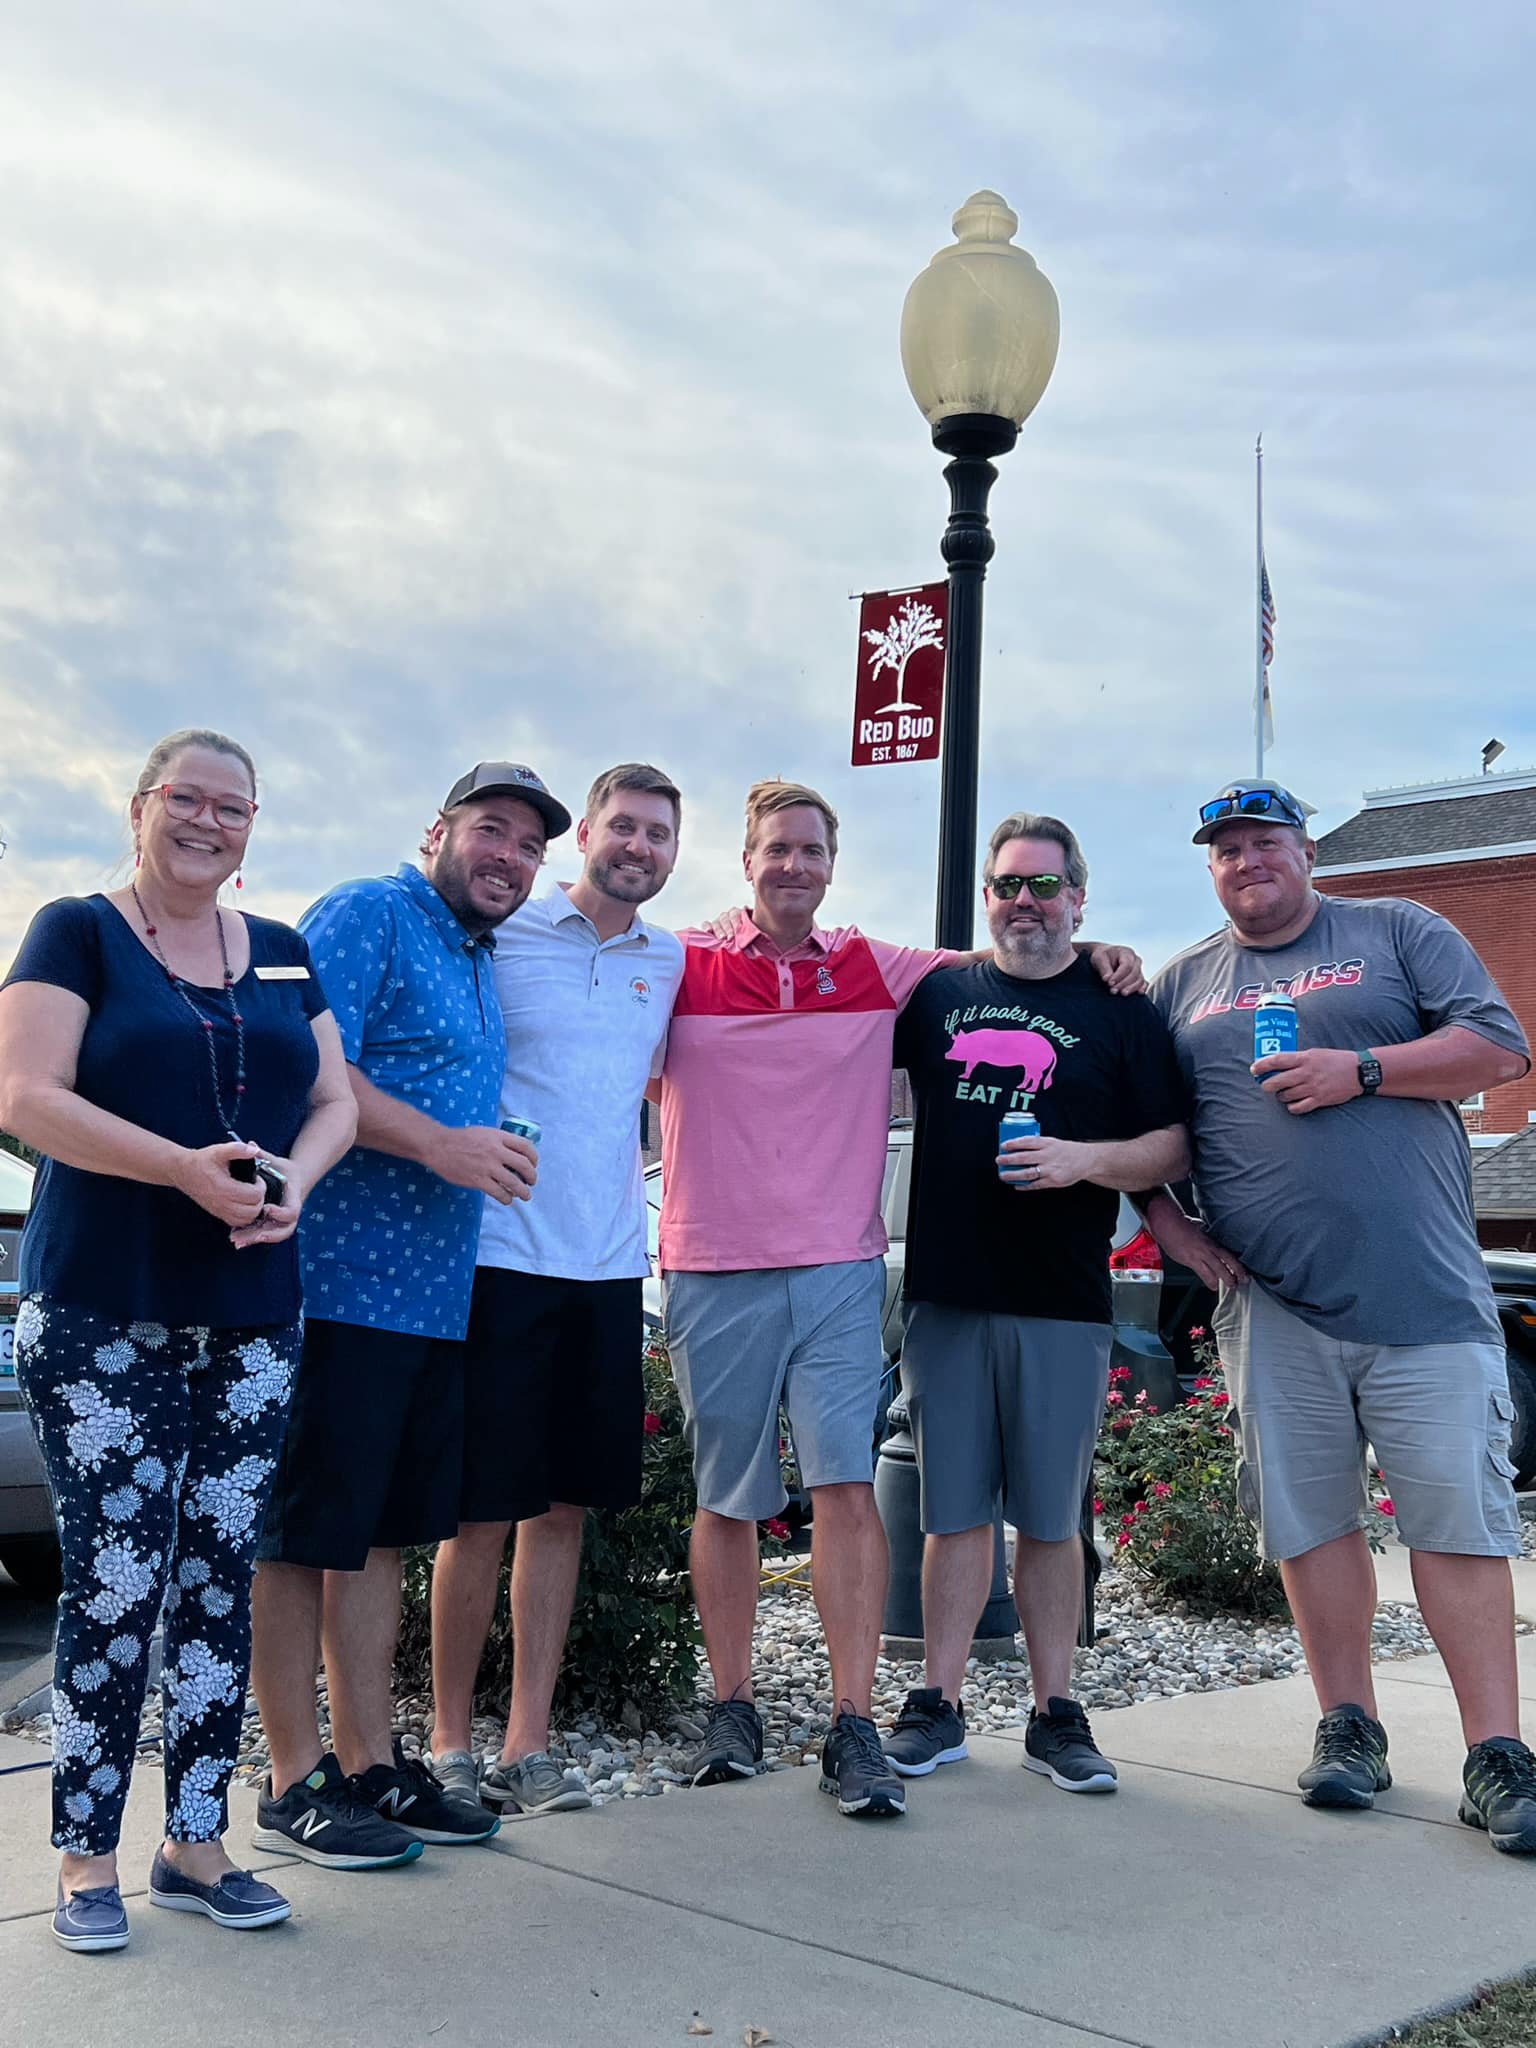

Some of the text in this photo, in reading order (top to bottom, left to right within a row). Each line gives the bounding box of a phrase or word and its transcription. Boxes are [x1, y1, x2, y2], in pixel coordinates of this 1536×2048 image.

[859, 715, 934, 745] RED BUD
[871, 743, 918, 761] EST. 1867
[944, 1004, 1081, 1049] if it looks good
[955, 1081, 1036, 1110] EAT IT
[290, 1807, 332, 1841] N
